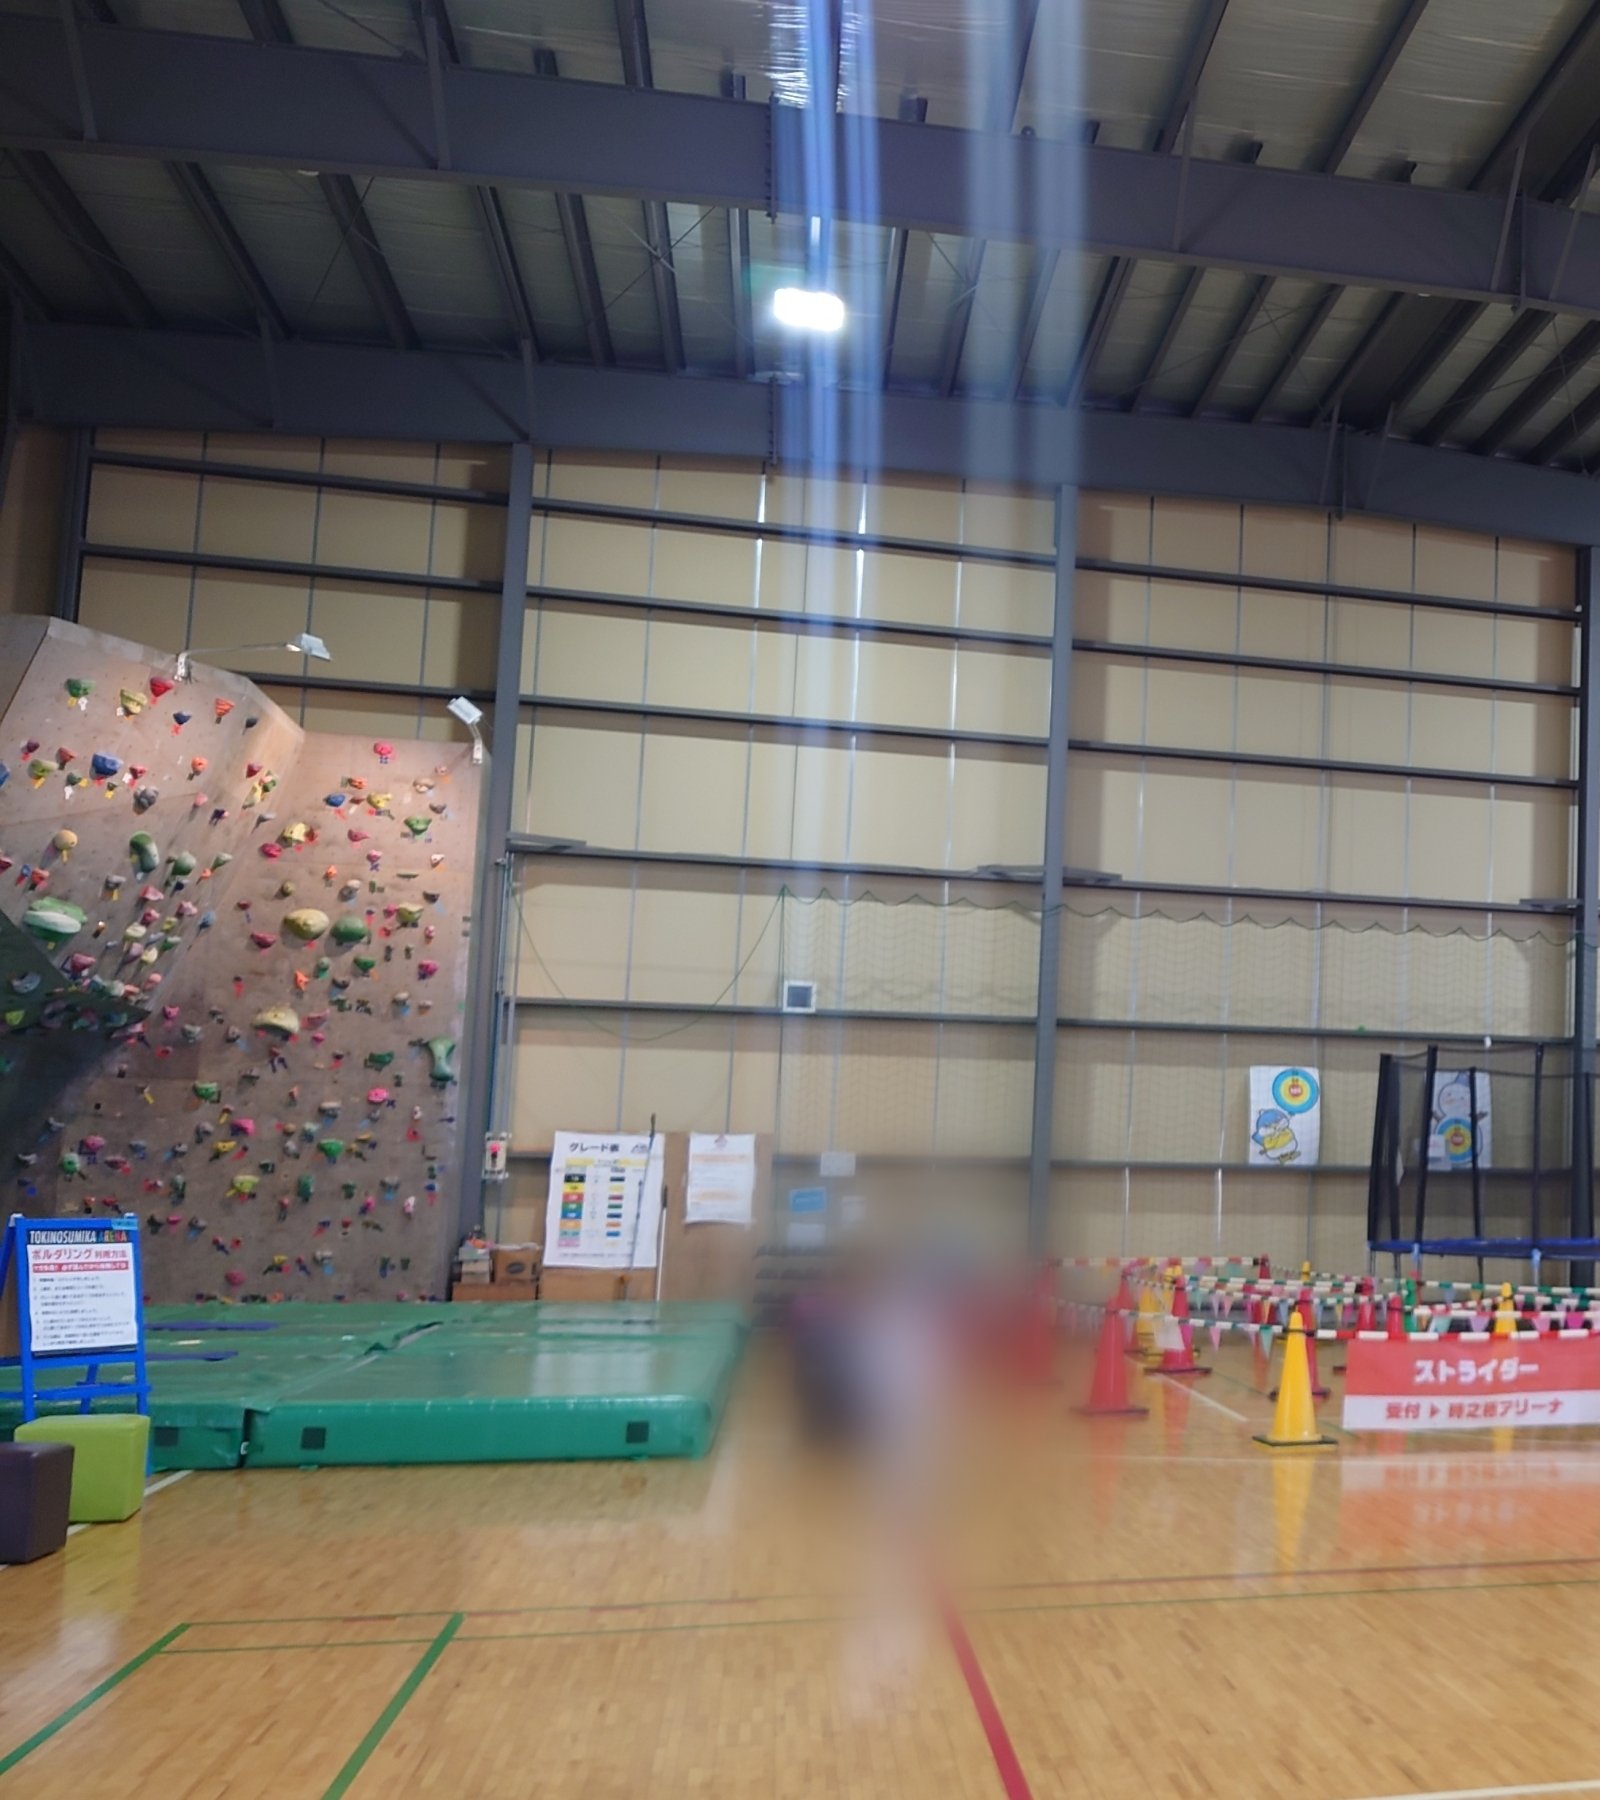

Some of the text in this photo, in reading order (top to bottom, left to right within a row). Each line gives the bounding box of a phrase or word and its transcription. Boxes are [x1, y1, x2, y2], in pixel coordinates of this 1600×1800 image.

[29, 1230, 128, 1244] TOKINOSUMIKA ARENA
[31, 1248, 93, 1260] ボルダリング
[1413, 1356, 1540, 1385] ストライダー
[1384, 1402, 1421, 1420] 受付
